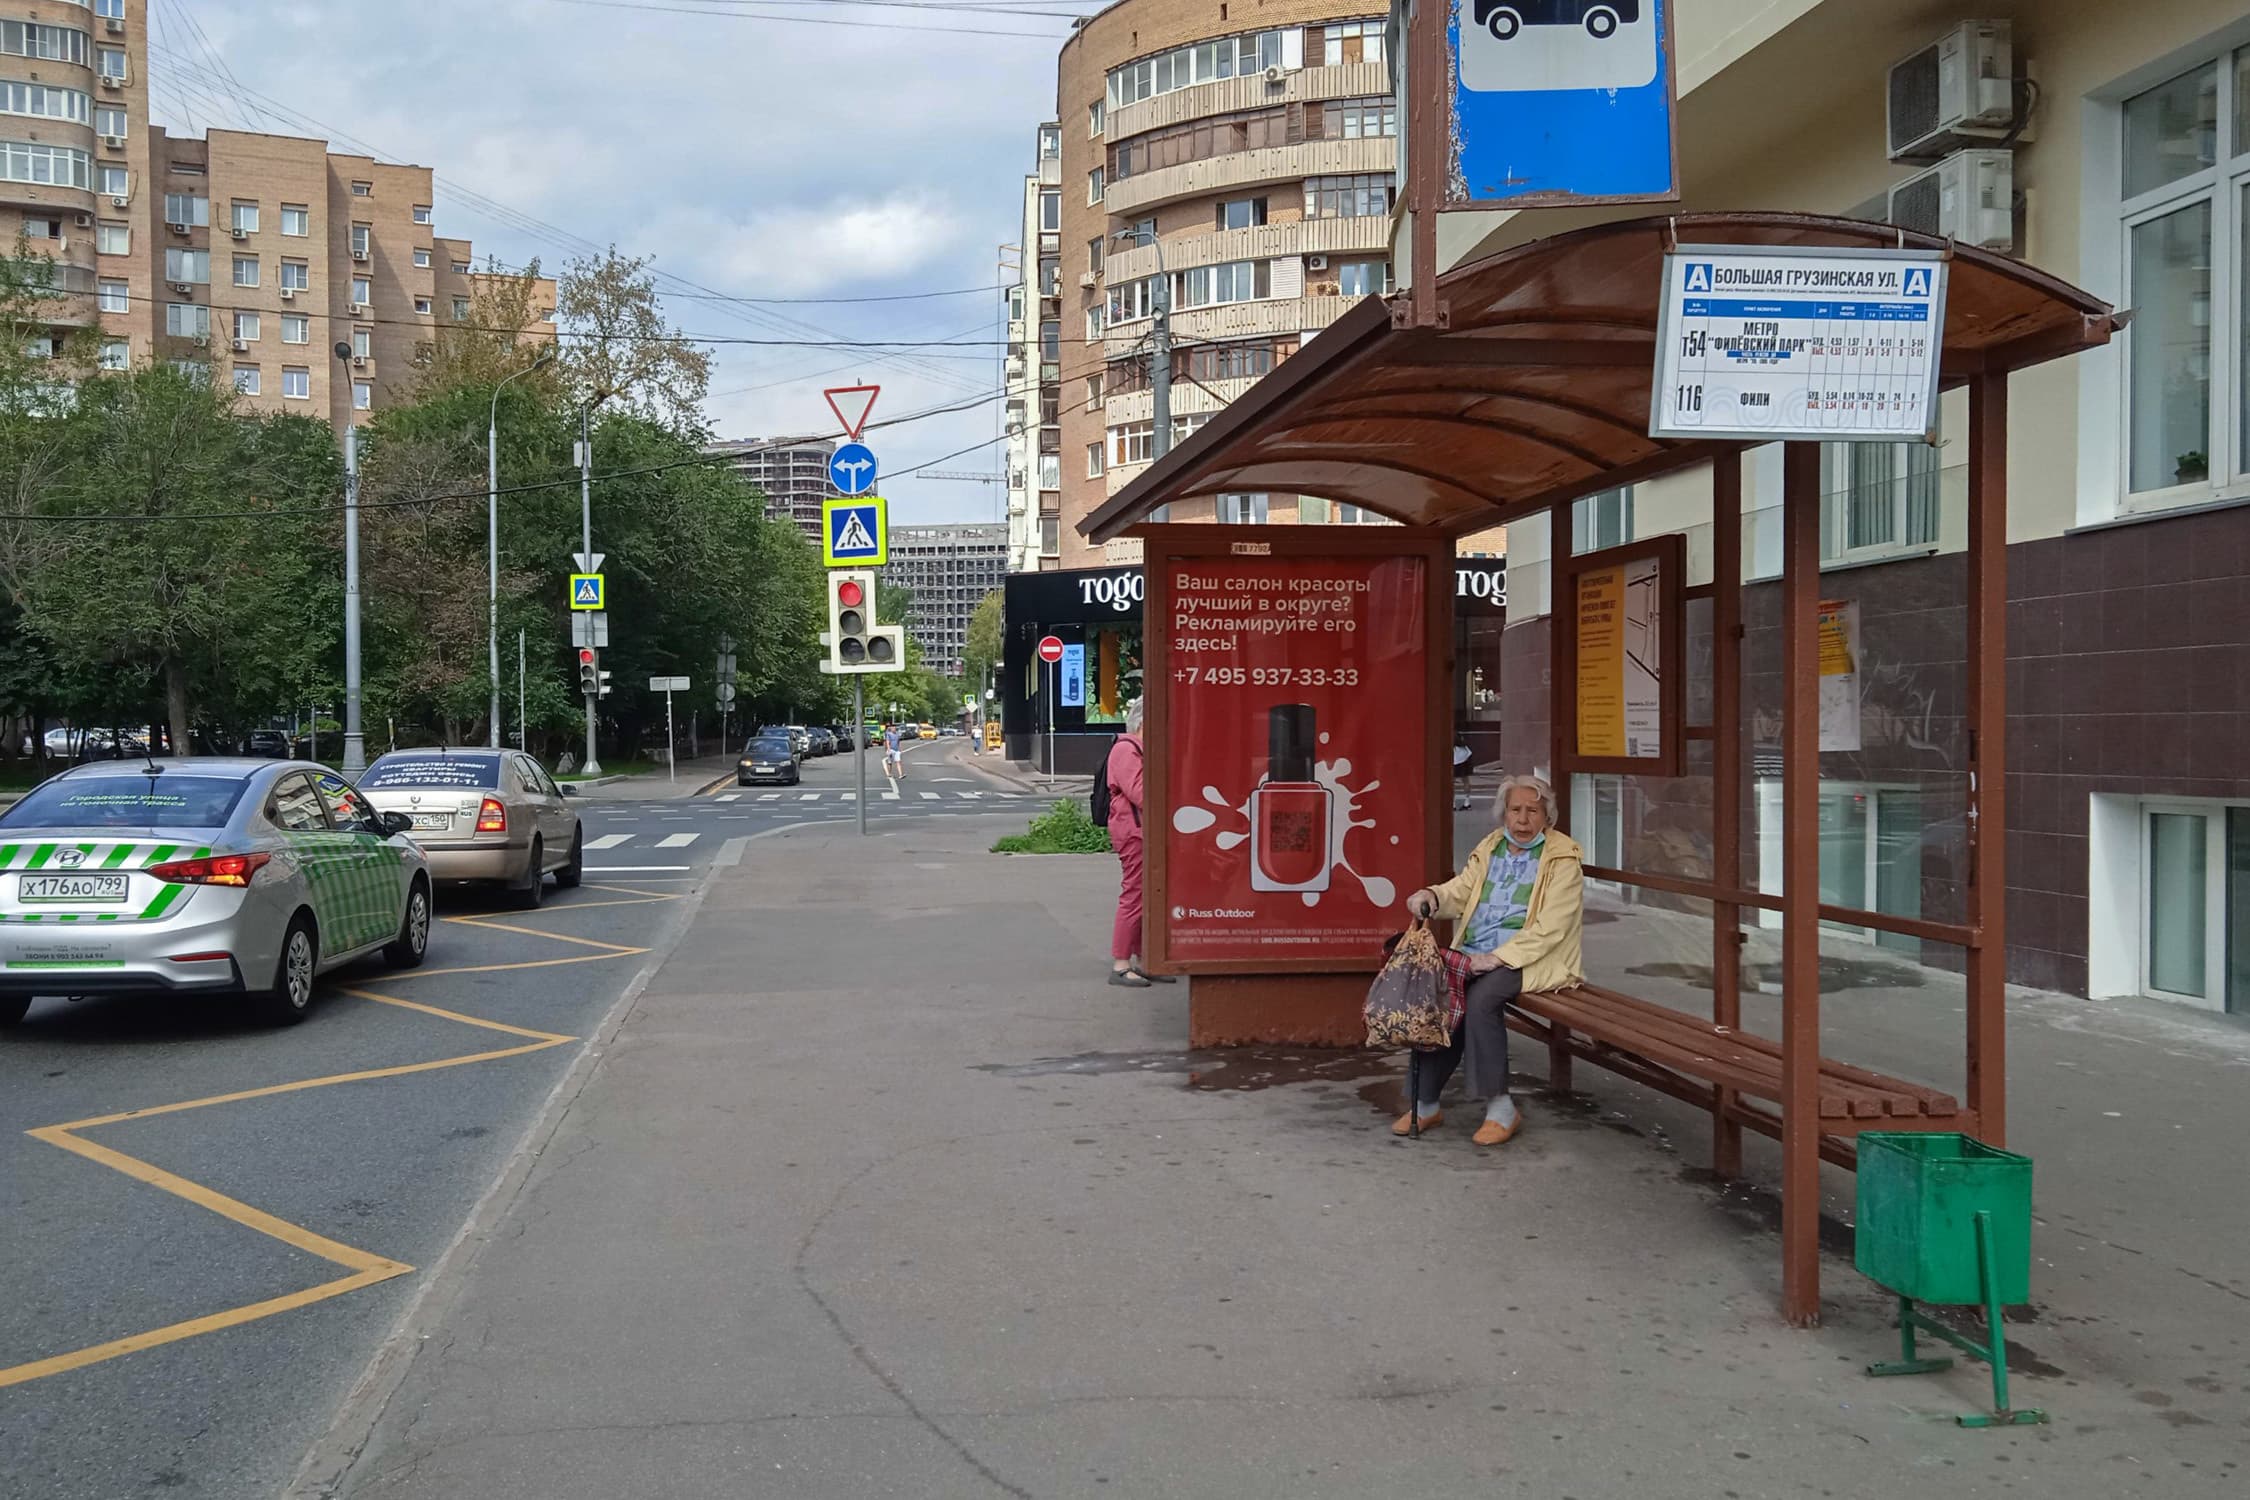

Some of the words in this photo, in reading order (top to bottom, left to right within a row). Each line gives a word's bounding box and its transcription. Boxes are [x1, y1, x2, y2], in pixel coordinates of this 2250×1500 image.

[1714, 268, 1783, 285] БОЛЬШАЯ
[1786, 269, 1874, 288] ГРУЗИНСКАЯ
[1878, 271, 1899, 288] УЛ.
[1743, 322, 1779, 336] МЕТРО
[1678, 384, 1702, 411] 116
[1740, 392, 1770, 406] ФИЛИ
[1176, 574, 1219, 590] Ваш
[1224, 577, 1283, 591] салон
[1288, 578, 1371, 595] красоты
[1175, 595, 1252, 613] лучший
[1259, 599, 1269, 611] в
[1275, 596, 1351, 616] округе?
[1175, 614, 1317, 635] Рекламируйте
[1323, 618, 1356, 632] его
[1175, 635, 1237, 653] здесь!
[1174, 667, 1199, 684] +7
[1204, 668, 1246, 685] 495
[1252, 668, 1359, 686] 937-33-33
[430, 814, 446, 822] 150
[97, 877, 122, 890] 799
[1189, 908, 1213, 918] Russ
[1215, 908, 1255, 918] Outdoor
